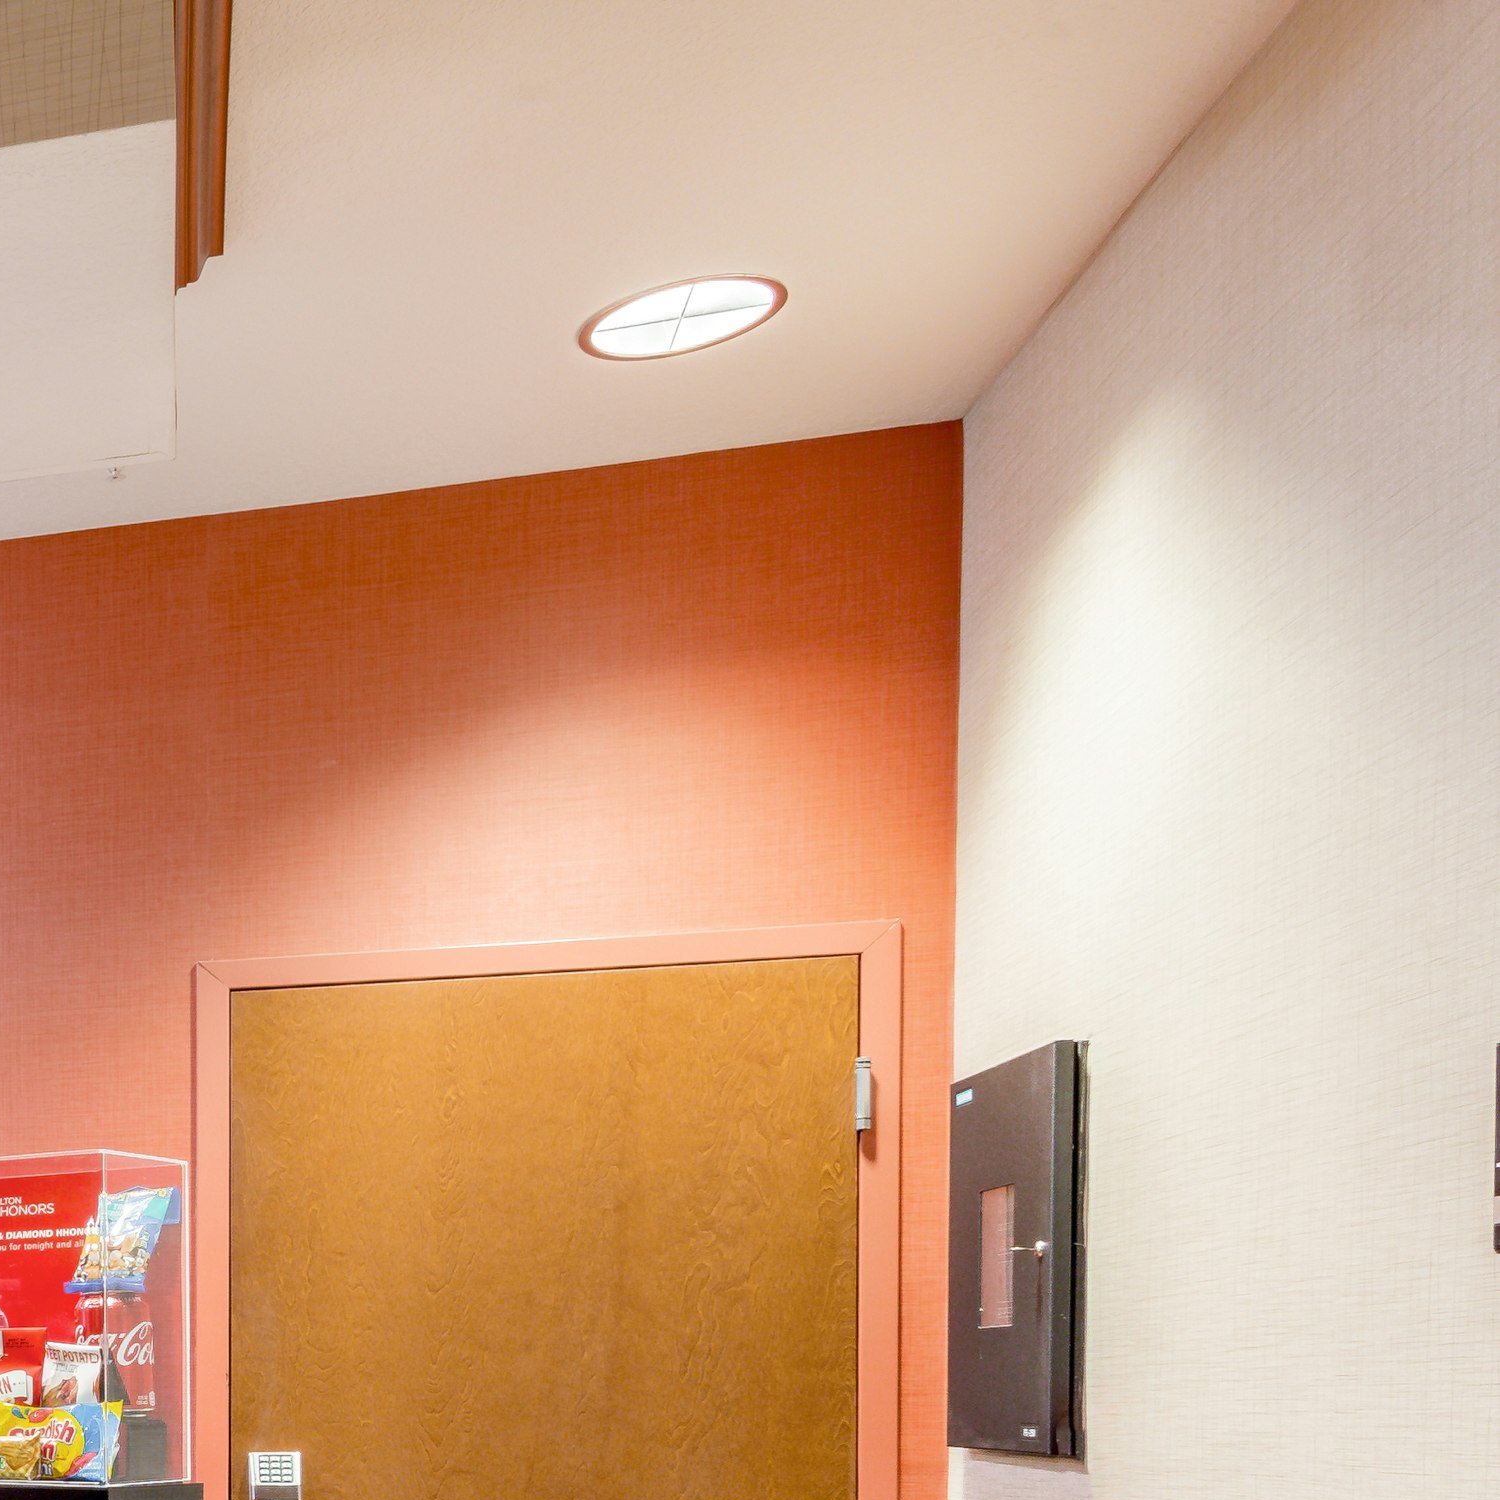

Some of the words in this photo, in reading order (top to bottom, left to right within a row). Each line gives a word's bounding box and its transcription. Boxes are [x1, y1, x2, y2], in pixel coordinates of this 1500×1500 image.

[5, 1228, 54, 1240] DIAMOND
[9, 1242, 22, 1251] for
[23, 1241, 54, 1252] tonight
[55, 1239, 73, 1249] and
[74, 1238, 85, 1248] all
